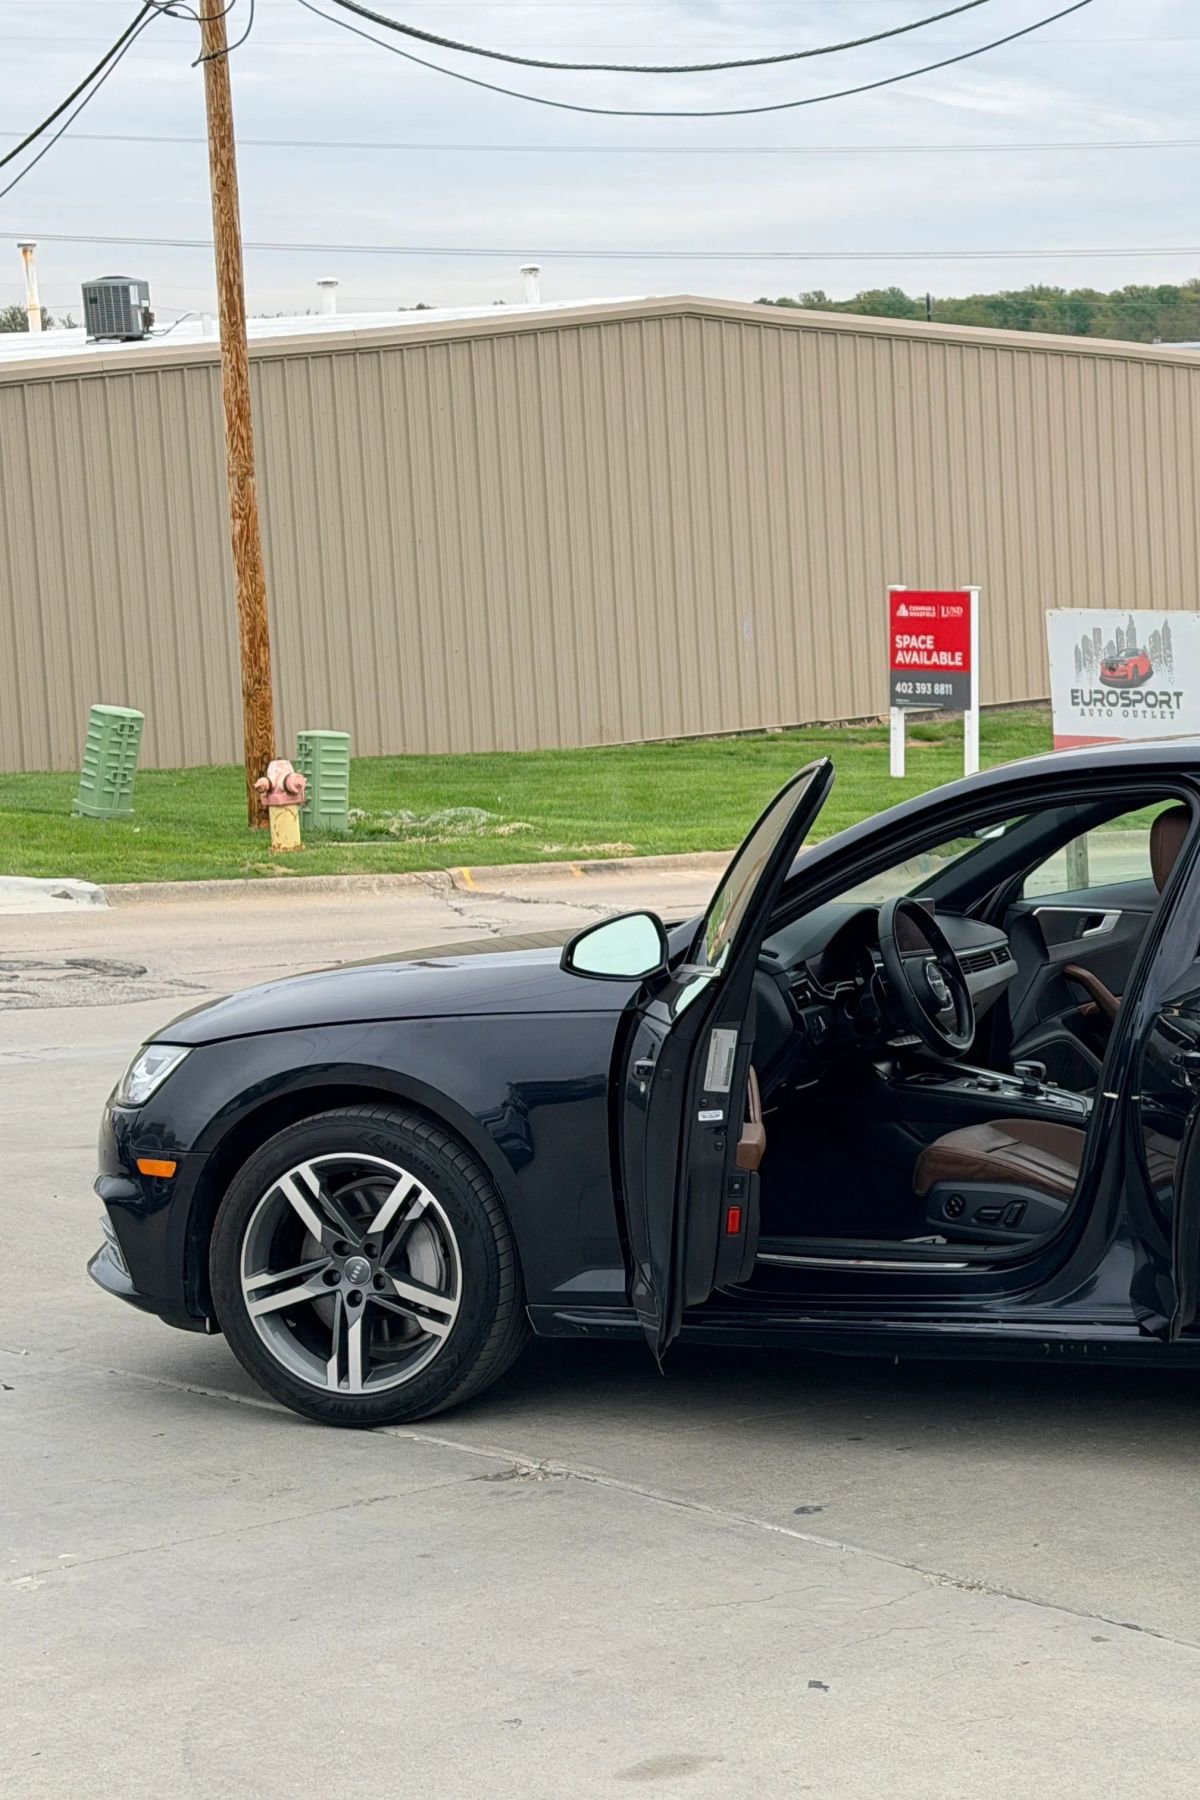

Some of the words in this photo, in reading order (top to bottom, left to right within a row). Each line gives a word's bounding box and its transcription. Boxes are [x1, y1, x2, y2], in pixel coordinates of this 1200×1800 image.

[941, 605, 963, 618] LUND
[895, 634, 935, 650] SPACE
[895, 650, 963, 666] AVAILABLE
[895, 682, 913, 694] 402
[915, 682, 932, 695] 393
[934, 683, 953, 695] 8811
[1070, 688, 1184, 709] EUROSPORT
[1080, 708, 1113, 717] AUTO
[1122, 709, 1175, 720] OUTLET
